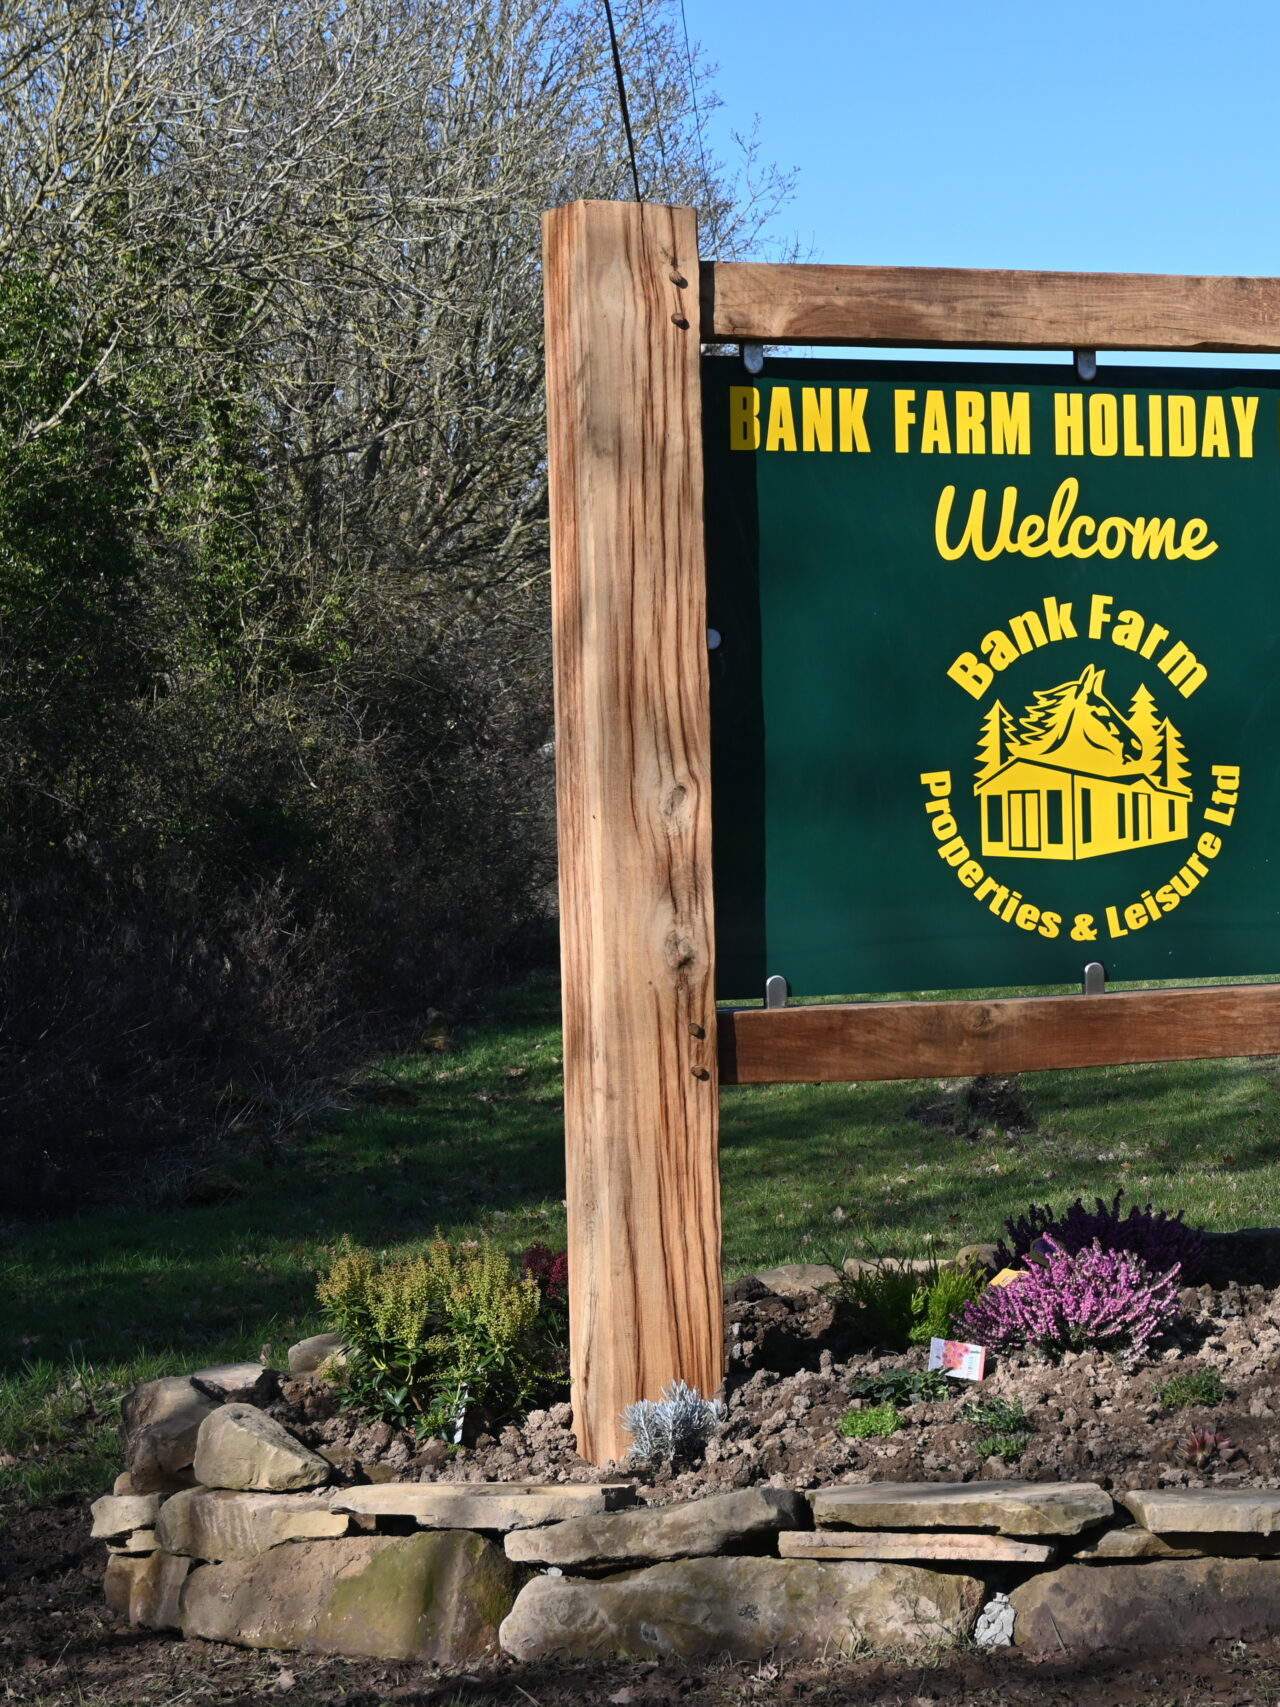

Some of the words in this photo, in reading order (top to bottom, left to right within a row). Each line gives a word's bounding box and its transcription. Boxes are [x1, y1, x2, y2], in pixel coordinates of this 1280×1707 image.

[729, 385, 872, 454] BANK
[893, 388, 1033, 456] FARM
[1054, 392, 1260, 460] HOLIDAY
[934, 476, 1220, 562] Welcome
[945, 596, 1079, 701] Bank
[1088, 593, 1209, 699] Farm
[919, 770, 1063, 939] Properties
[1069, 913, 1099, 943] &
[1105, 831, 1223, 939] Leisure
[1203, 764, 1241, 827] Ltd
